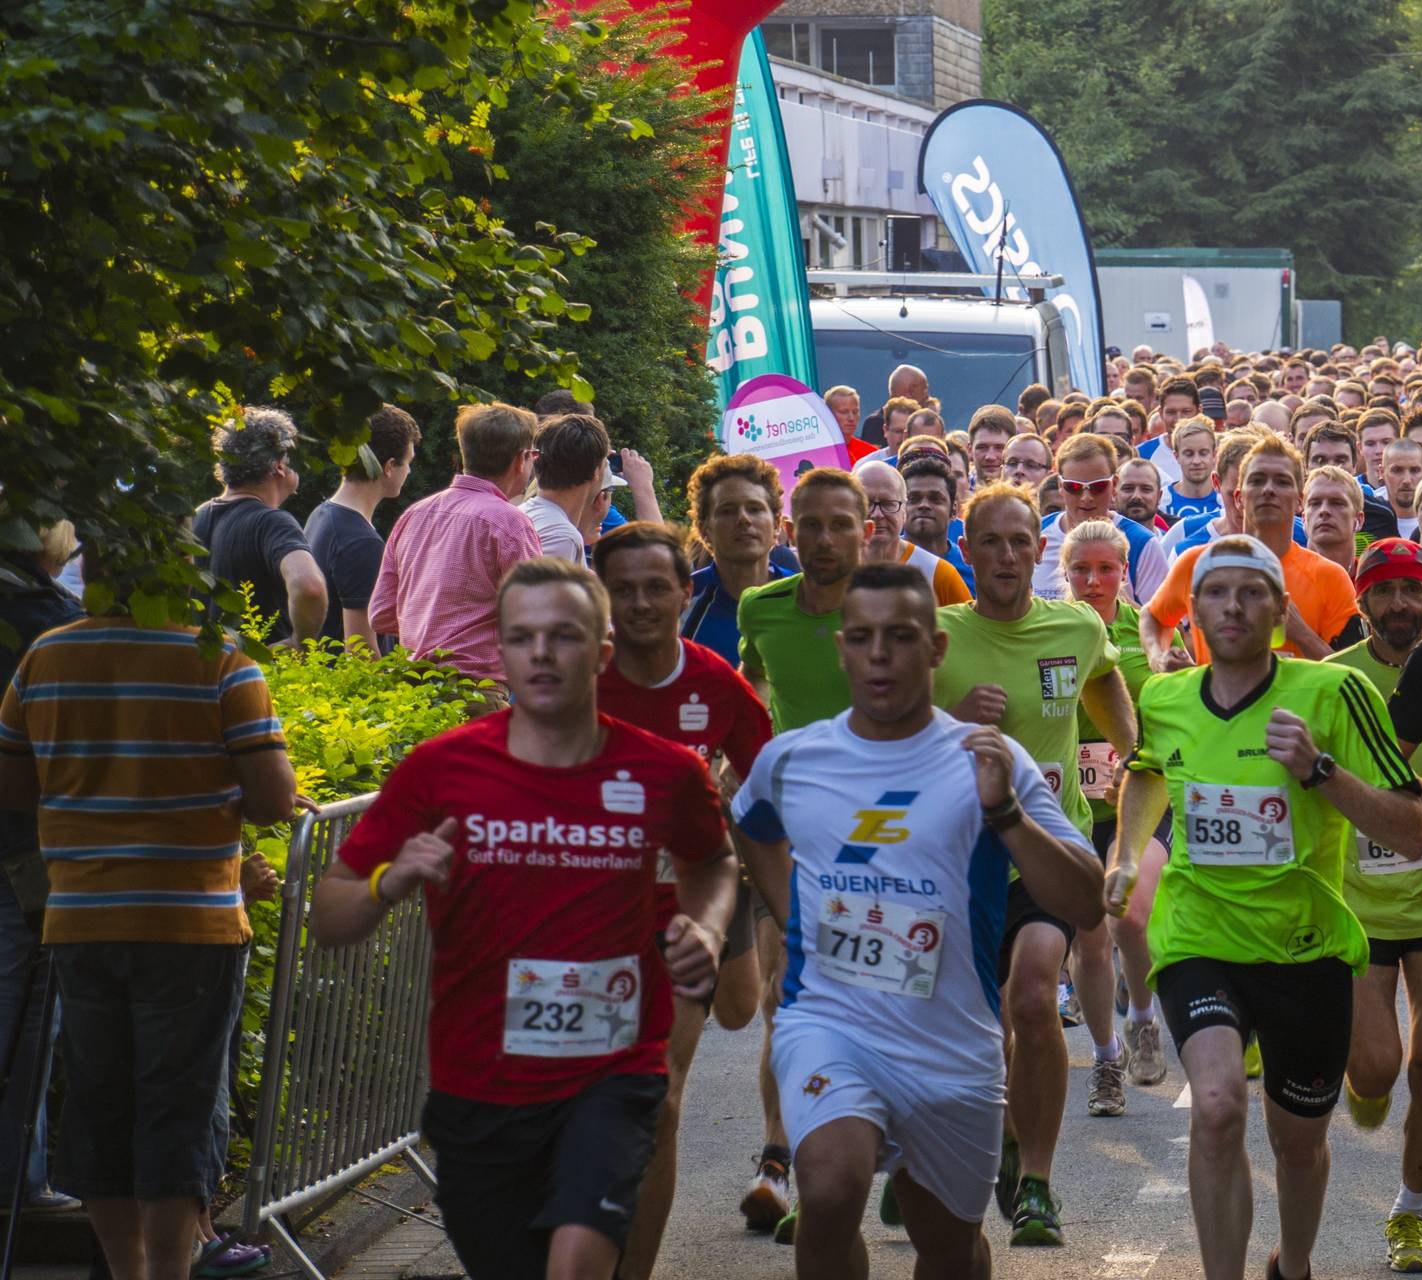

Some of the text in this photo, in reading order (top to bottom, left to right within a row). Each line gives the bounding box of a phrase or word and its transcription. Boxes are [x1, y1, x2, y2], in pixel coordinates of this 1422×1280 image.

[1195, 818, 1242, 845] 538
[467, 849, 494, 864] Gut
[497, 848, 521, 865] für
[526, 851, 556, 866] das
[829, 929, 884, 967] 713
[523, 1000, 585, 1033] 232
